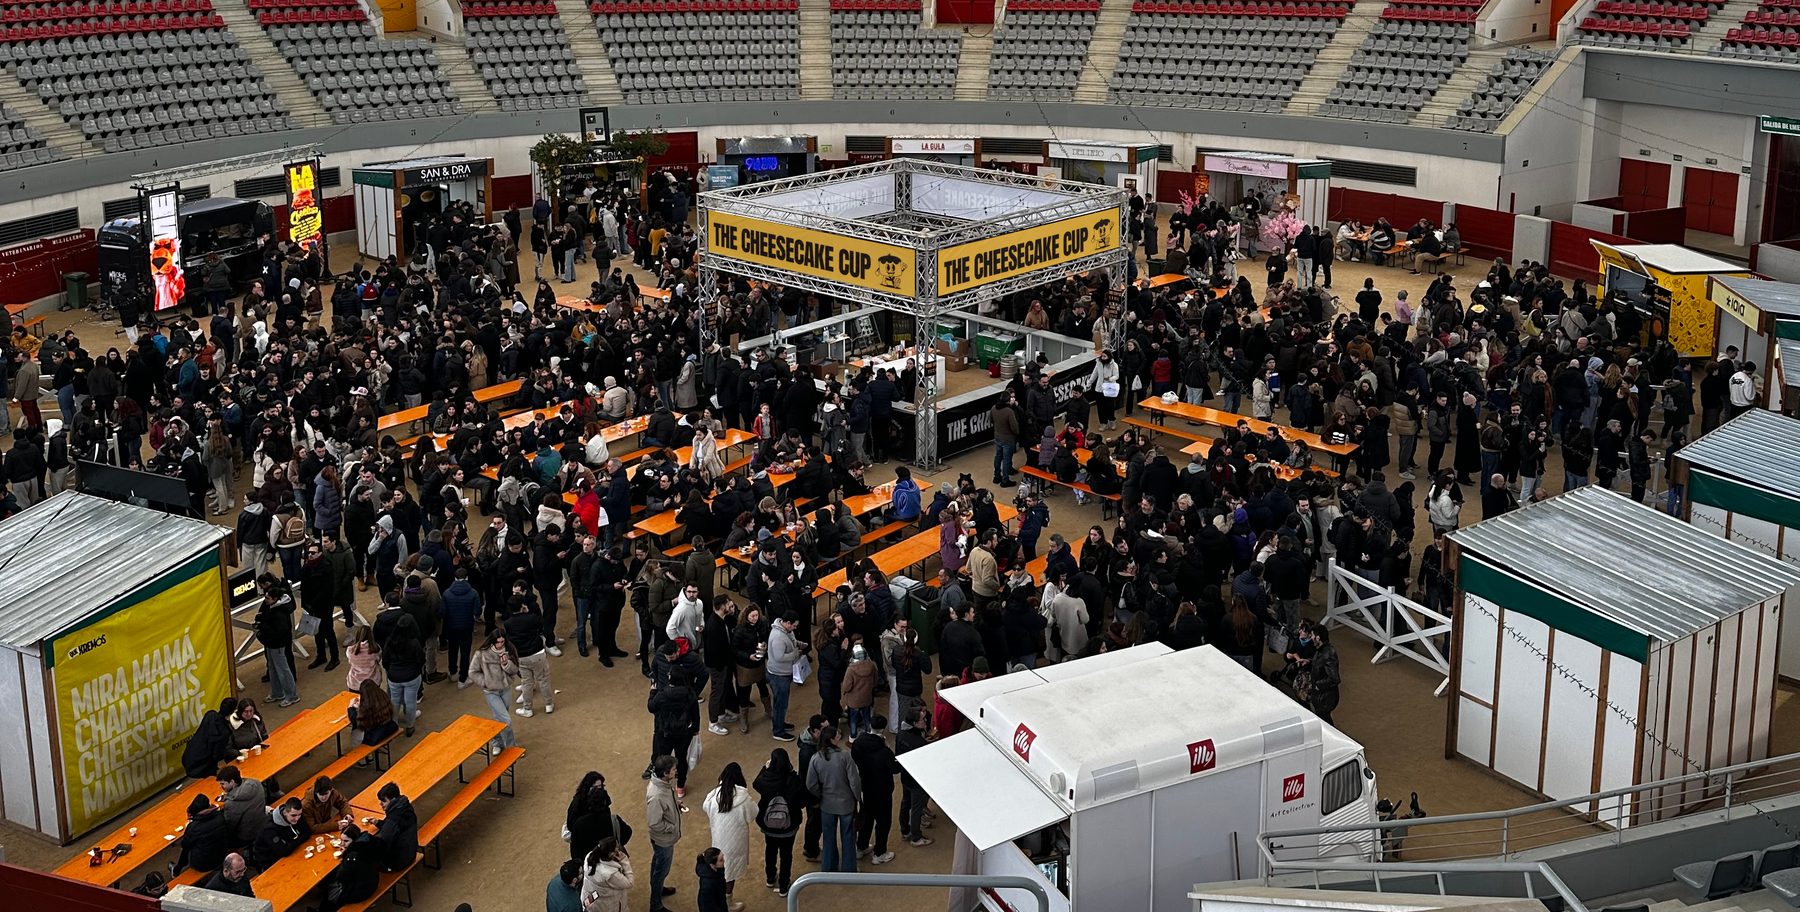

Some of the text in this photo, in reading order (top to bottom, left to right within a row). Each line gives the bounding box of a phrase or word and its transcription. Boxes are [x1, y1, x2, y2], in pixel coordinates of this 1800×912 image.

[421, 165, 471, 179] SAN & DRA
[713, 222, 871, 279] THE CHEESECAKE CUP
[944, 227, 1088, 287] THE CHEESECAKE CUP
[947, 417, 967, 443] THE
[70, 627, 202, 721] MIRA MAMÁ.
[75, 663, 201, 753] CHAMPIONS
[78, 690, 206, 785] CHEESECAKE
[1015, 730, 1030, 754] illy
[1192, 745, 1214, 767] illy
[82, 747, 175, 819] MADRID.
[1284, 779, 1304, 798] illy
